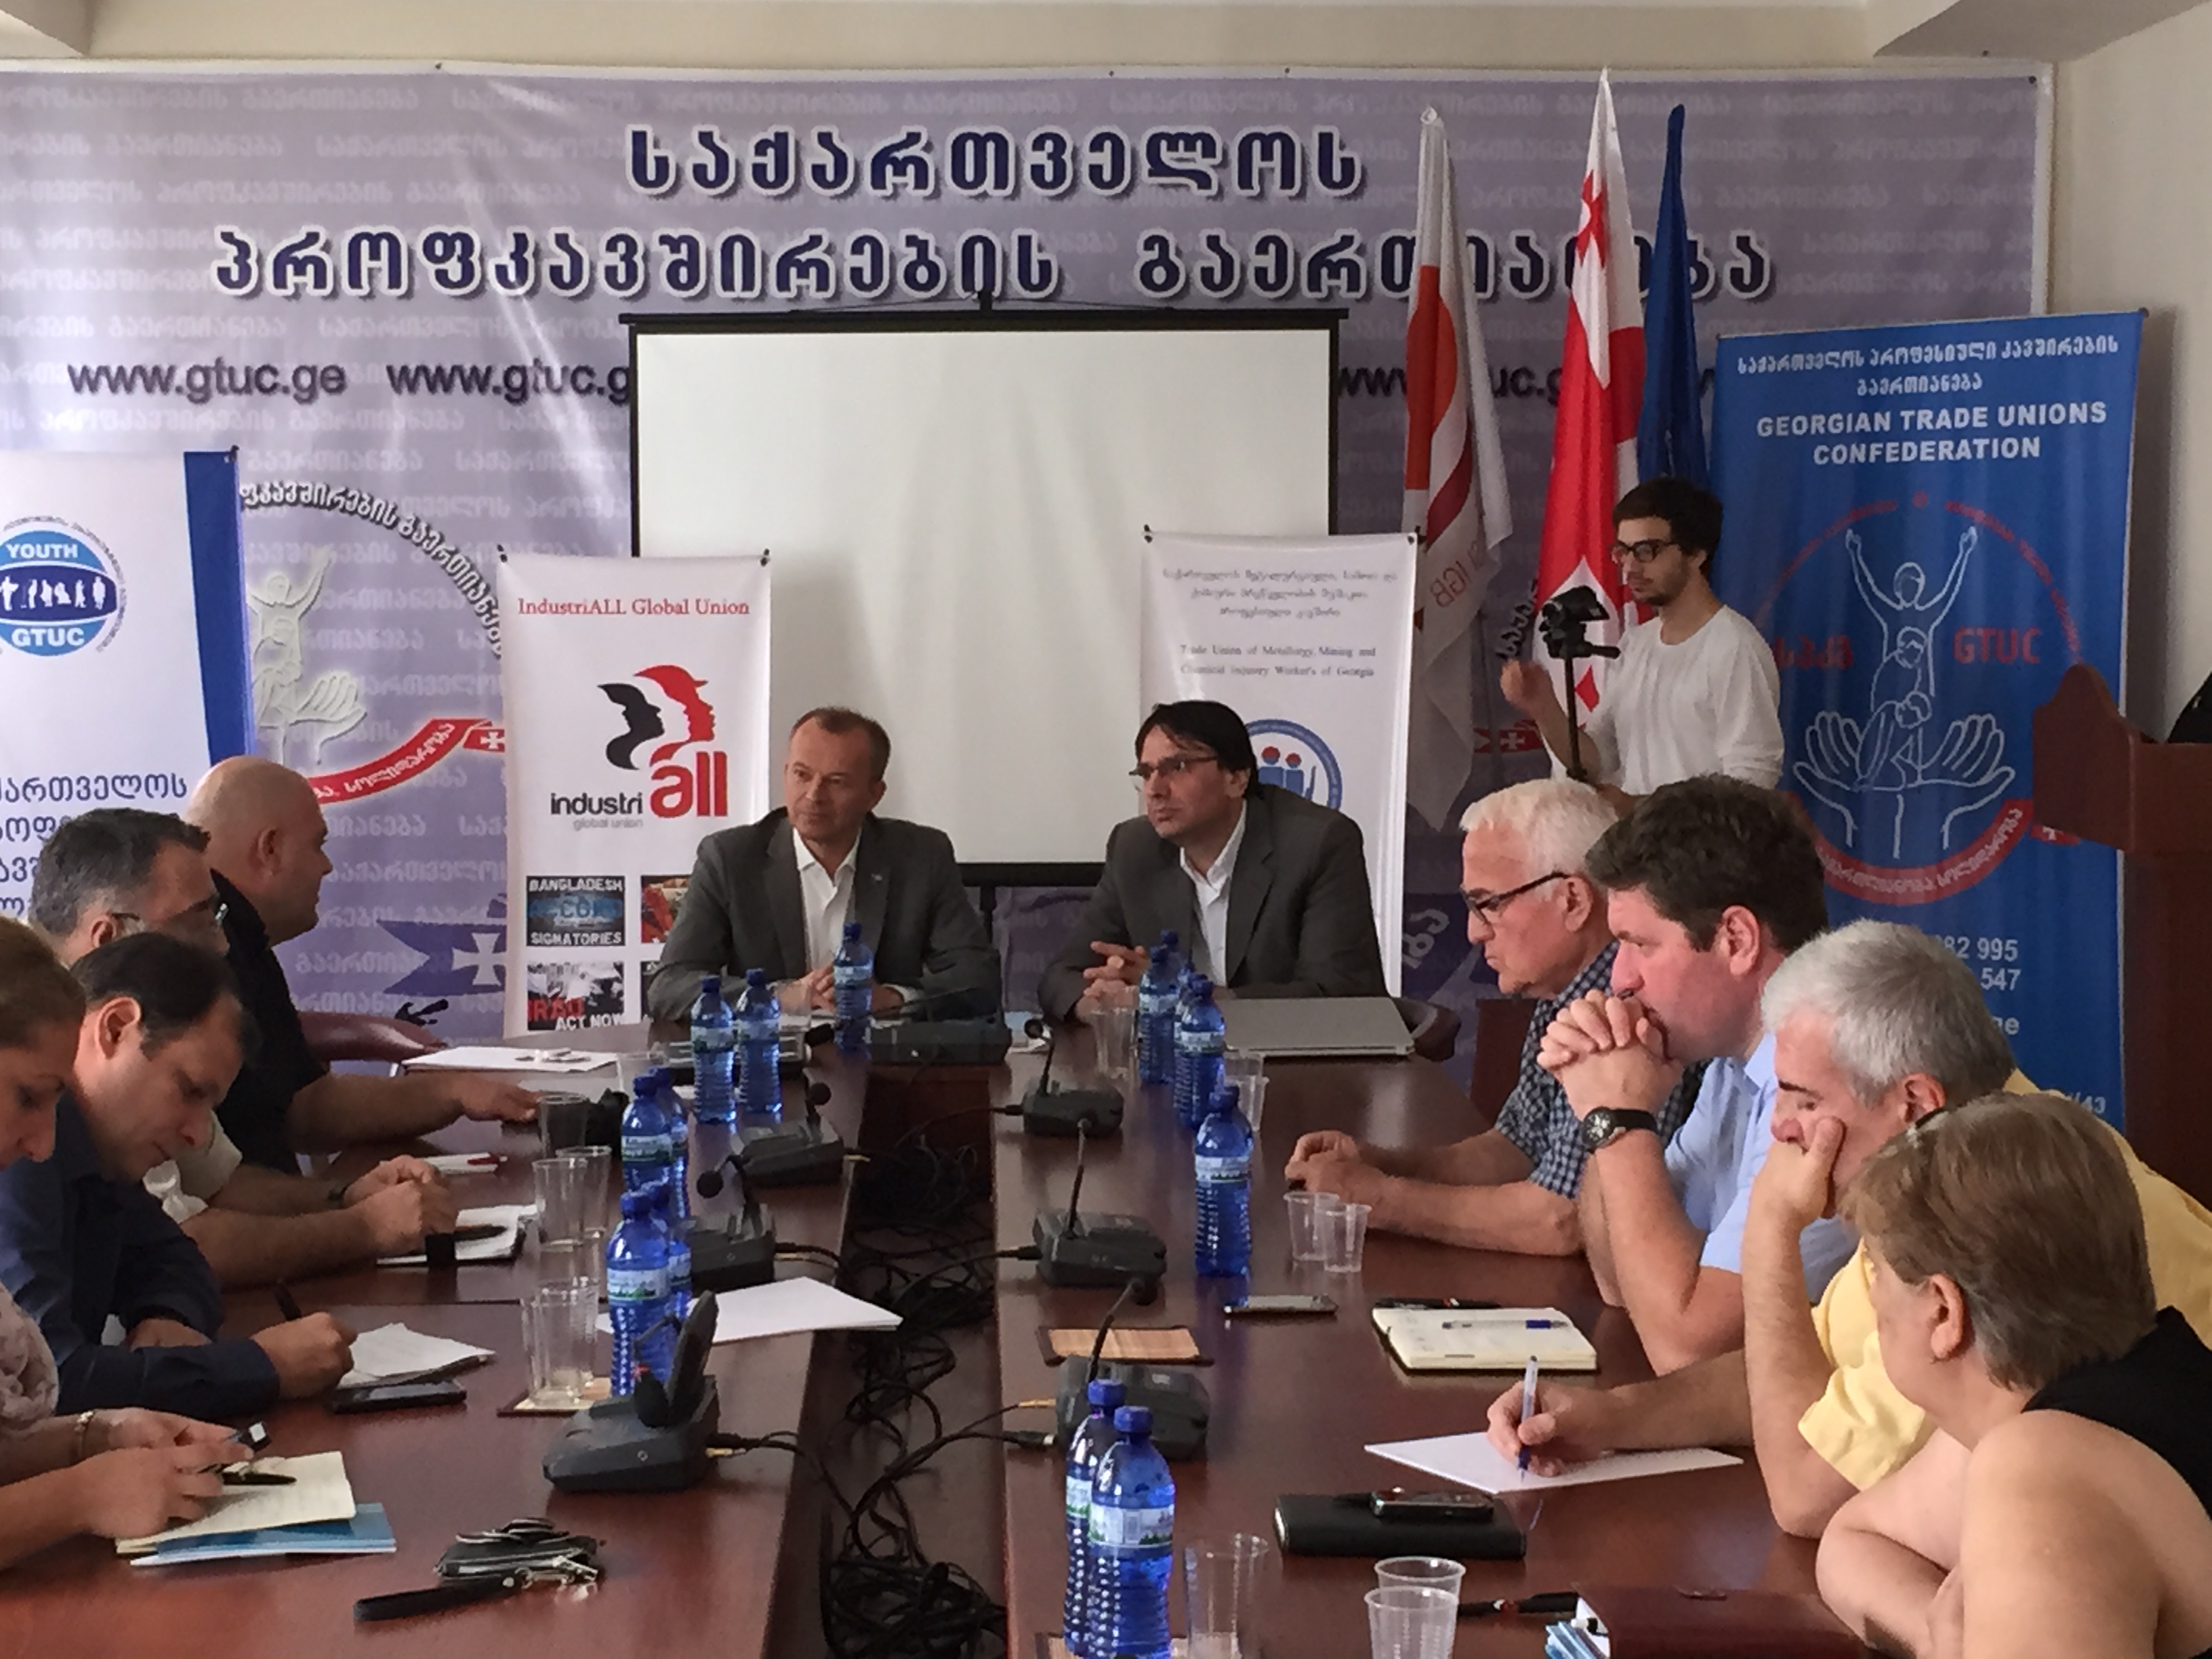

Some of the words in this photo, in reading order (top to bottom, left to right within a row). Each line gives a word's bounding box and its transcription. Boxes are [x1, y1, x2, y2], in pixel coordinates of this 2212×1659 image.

[625, 124, 1364, 199] საქართველოს
[211, 224, 1060, 300] პროფკავშირების
[1736, 350, 1865, 375] საქართველოს
[1868, 340, 1998, 368] პროფესიული
[2000, 335, 2119, 361] კავშირების
[66, 356, 349, 406] www.gtuc.ge
[385, 356, 629, 409] www.gtuc.g
[1856, 371, 1984, 397] გაერთიანება
[1755, 411, 1891, 438] GEORGIAN
[1900, 405, 1988, 432] TRADE
[1996, 401, 2108, 427] UNIONS
[1811, 435, 2042, 466] CONFEDERATION
[239, 480, 398, 531] ფკავშირების
[5, 543, 79, 559] YOUTH
[517, 598, 626, 615] IndustriALL
[632, 597, 689, 615] Global
[695, 598, 750, 615] Union
[11, 628, 85, 647] GTUC
[1953, 626, 2042, 665] GTUC
[0, 773, 187, 803] ართველოს
[550, 792, 643, 816] industri
[649, 751, 729, 818] all
[573, 817, 608, 832] global
[611, 818, 643, 830] union
[529, 878, 623, 893] BANGLADESH
[531, 931, 622, 946] SIGNATORIES
[1938, 935, 1971, 960] 82
[1976, 937, 2020, 962] 995
[1980, 967, 2022, 992] 547
[554, 1015, 587, 1031] ACT
[590, 1012, 625, 1027] NOW
